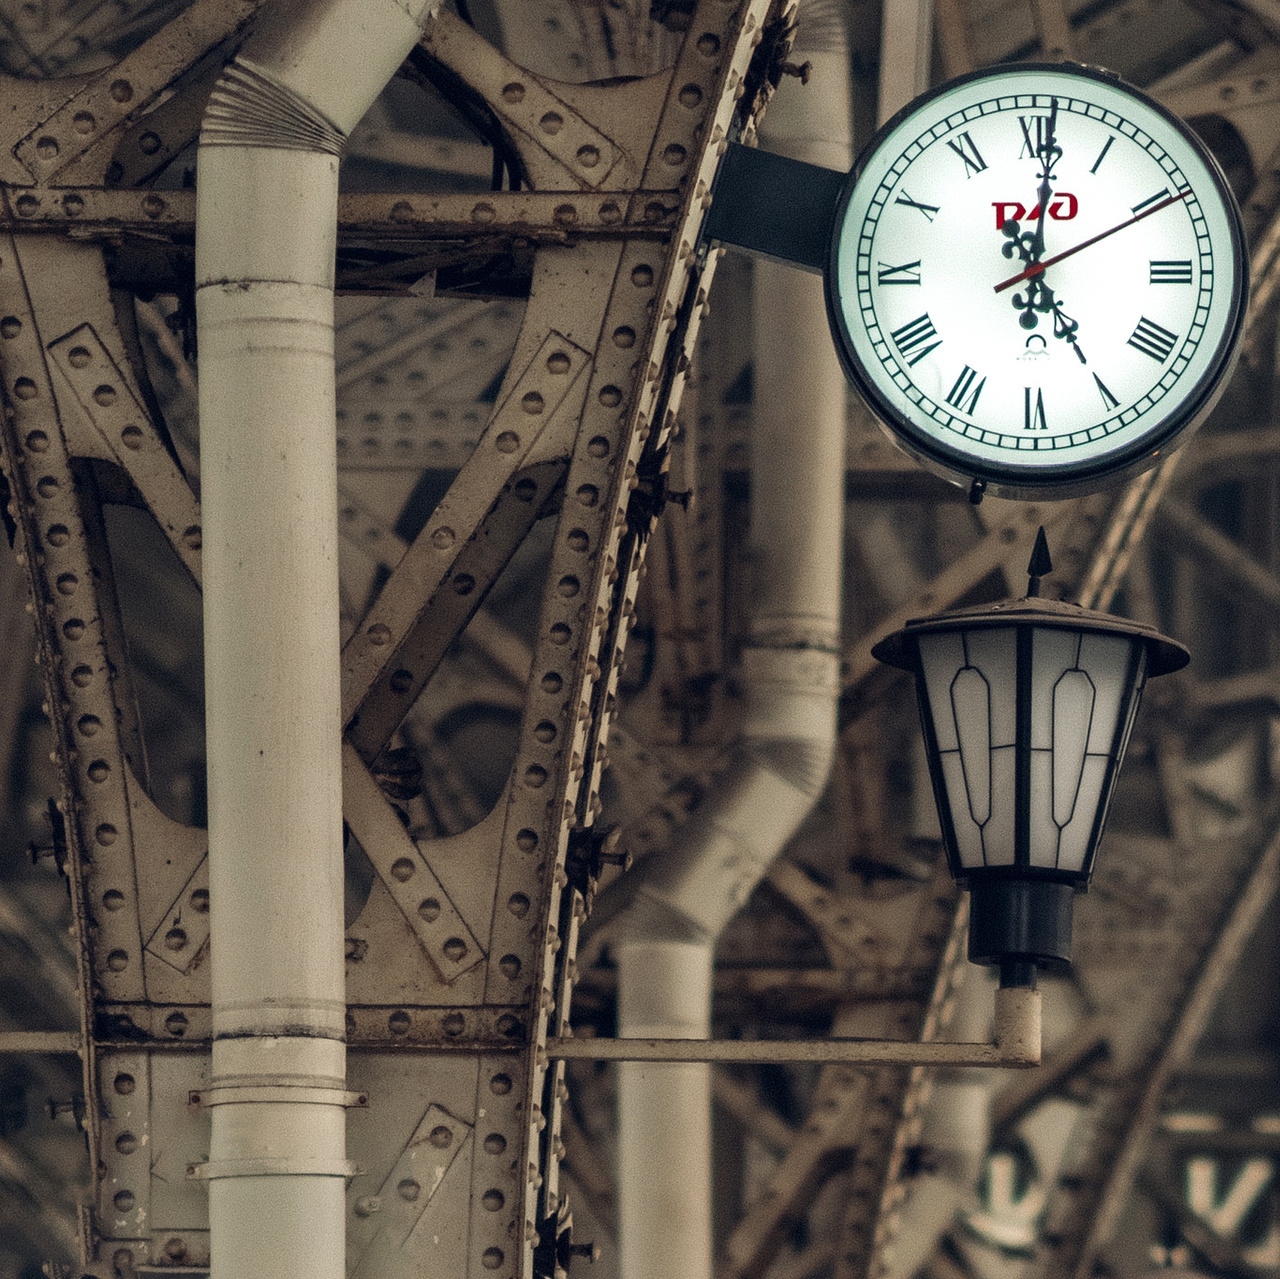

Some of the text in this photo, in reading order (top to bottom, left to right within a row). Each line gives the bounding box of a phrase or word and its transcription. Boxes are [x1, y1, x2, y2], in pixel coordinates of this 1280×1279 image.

[945, 130, 989, 180] XI
[1017, 115, 1053, 160] XII
[1089, 135, 1116, 175] I
[894, 188, 941, 223] X
[877, 259, 921, 287] IX
[1149, 259, 1192, 285] III
[889, 311, 943, 368] VIII
[1126, 314, 1179, 365] IIII
[944, 363, 987, 417] VII
[1023, 386, 1048, 430] VI
[1092, 371, 1121, 412] V
